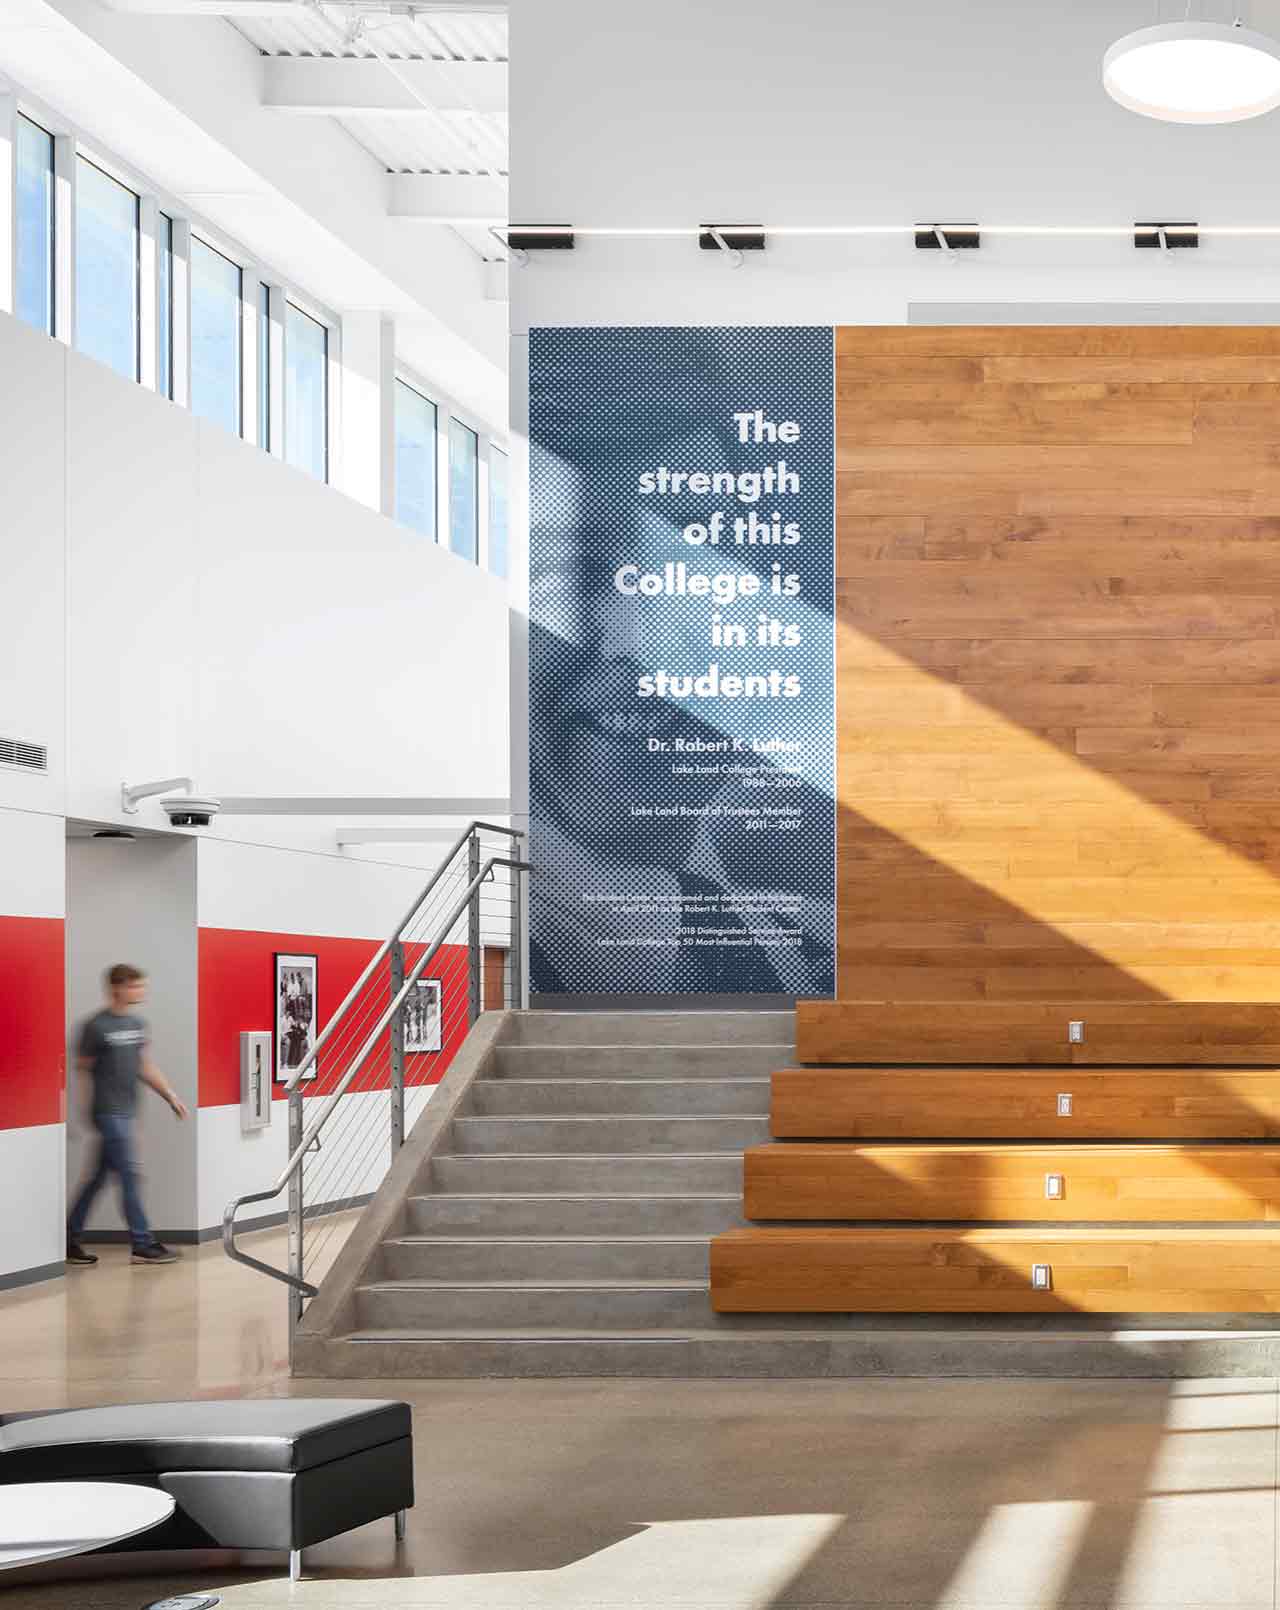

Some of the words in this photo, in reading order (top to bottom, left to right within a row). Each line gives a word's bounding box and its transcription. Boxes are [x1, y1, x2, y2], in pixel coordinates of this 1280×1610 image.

[733, 409, 801, 443] The
[638, 460, 800, 503] strength
[683, 511, 724, 545] of
[733, 511, 801, 545] this
[614, 561, 761, 605] College
[771, 560, 801, 596] is
[711, 612, 746, 647] in
[756, 612, 801, 647] its
[638, 663, 801, 698] students
[648, 738, 670, 752] Dr.
[675, 736, 729, 752] Robert
[732, 738, 749, 752] K.
[752, 737, 801, 752] Luther
[672, 764, 695, 774] Lake
[696, 764, 719, 774] Land
[721, 763, 757, 776] College
[631, 806, 653, 816] Lake
[656, 804, 679, 816] Land
[680, 804, 710, 816] Board
[711, 805, 722, 816] of
[763, 804, 801, 816] Member
[704, 893, 719, 902] and
[684, 904, 710, 913] Robert
[697, 926, 747, 937] Distinguished
[683, 938, 694, 946] 50
[696, 938, 715, 946] Most
